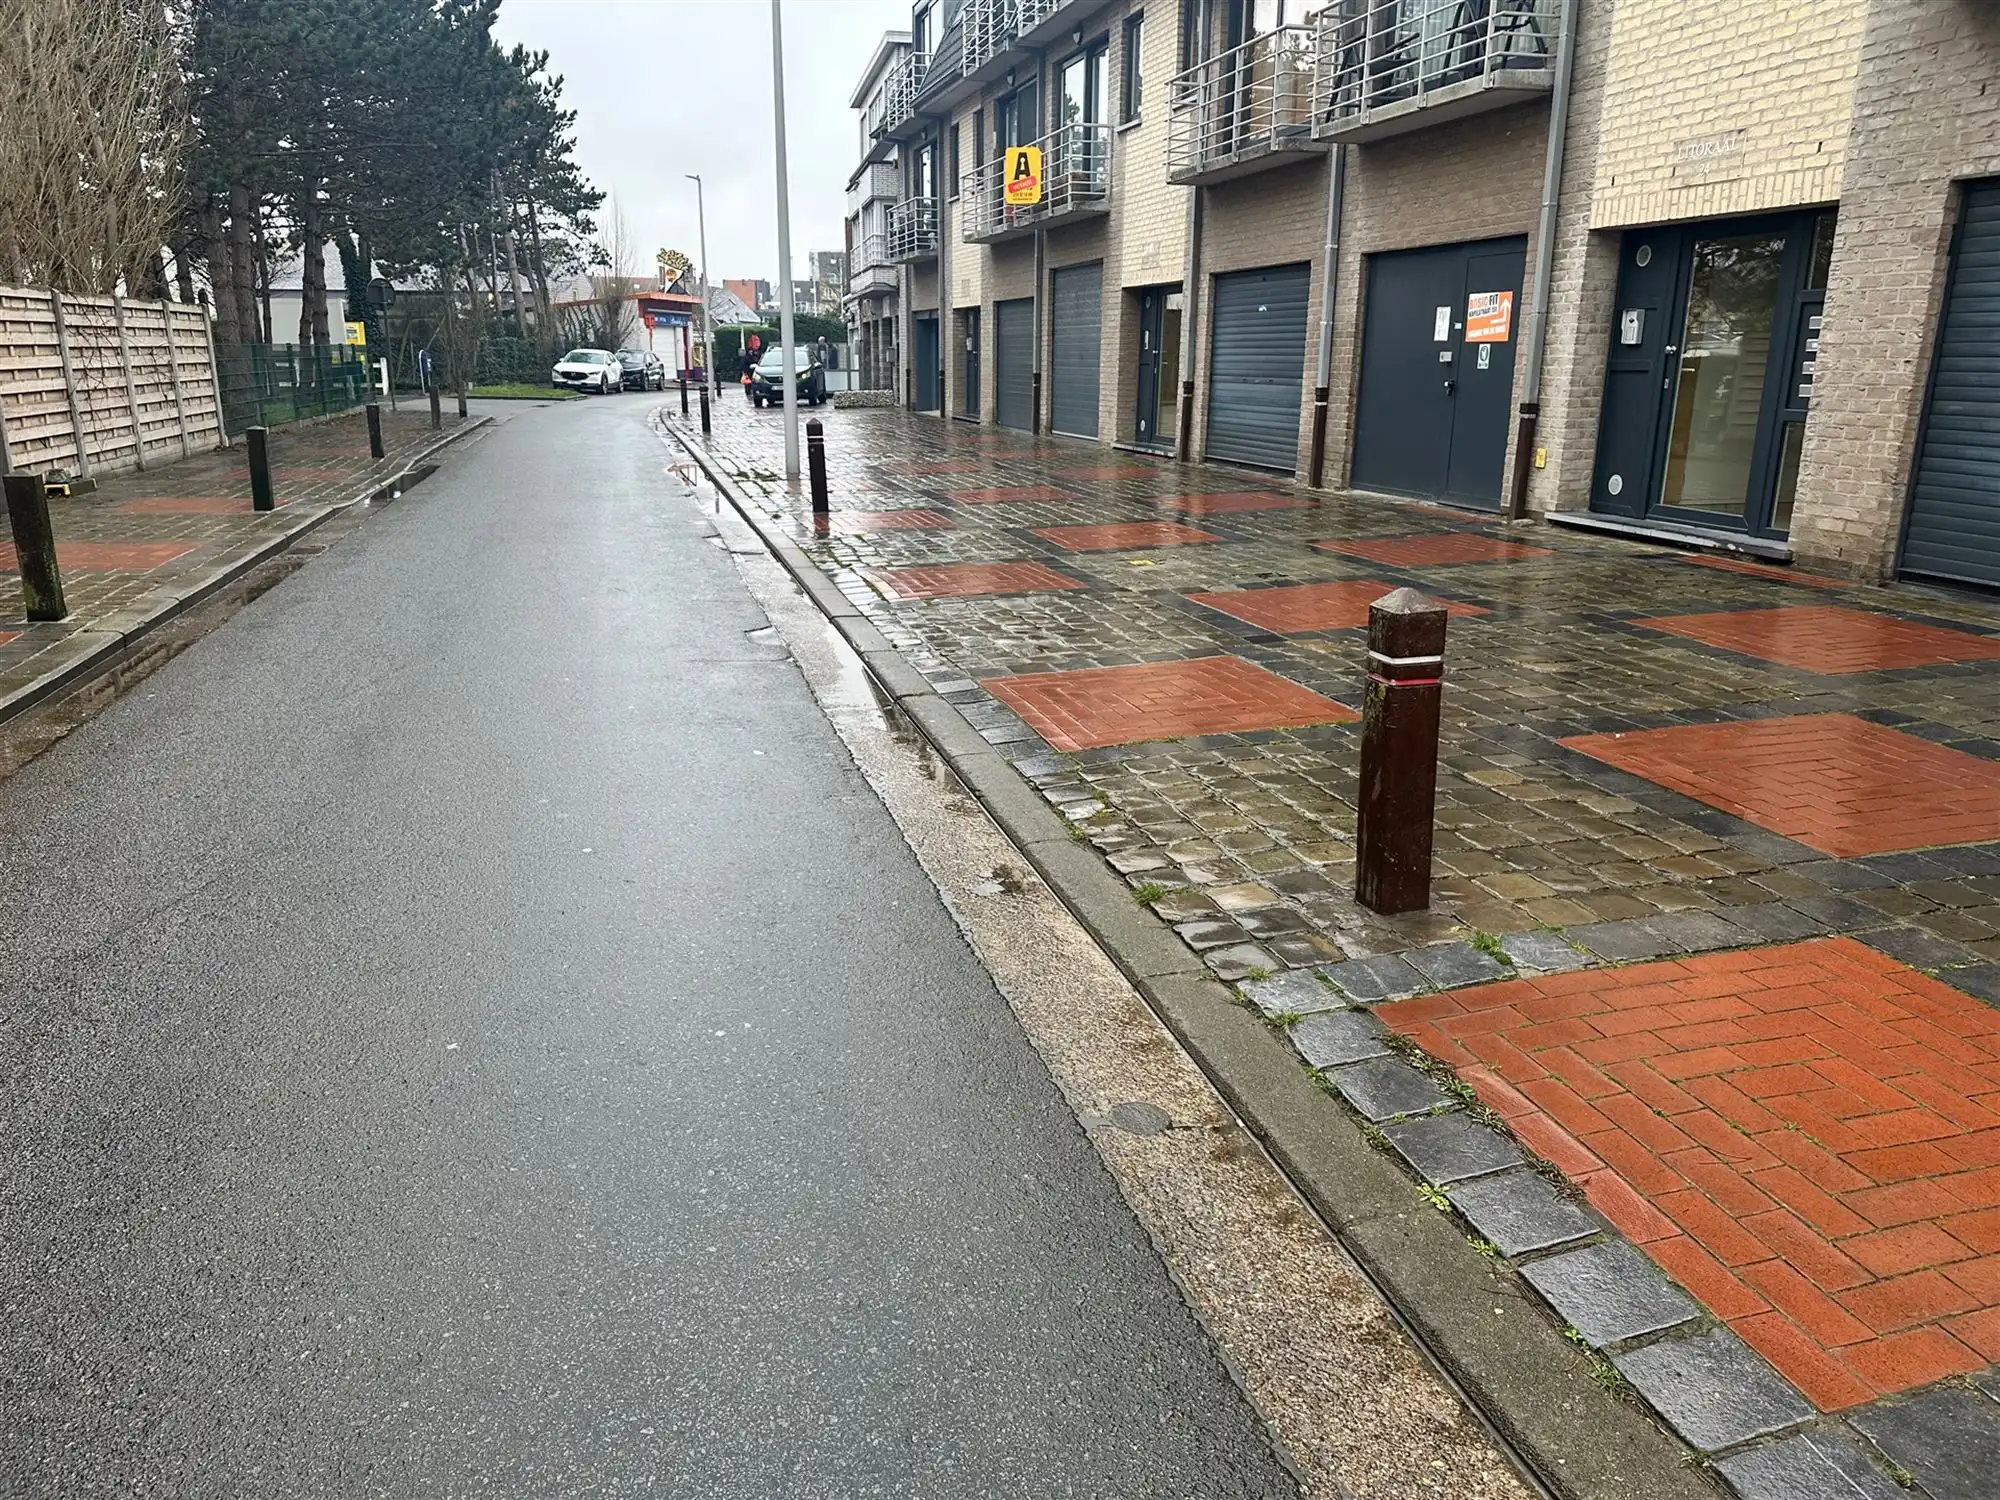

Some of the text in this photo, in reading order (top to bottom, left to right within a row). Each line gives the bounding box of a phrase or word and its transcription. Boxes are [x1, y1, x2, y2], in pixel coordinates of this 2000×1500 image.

[1678, 137, 1737, 161] LITORAAL
[1014, 151, 1031, 180] A
[1489, 294, 1498, 306] FIT
